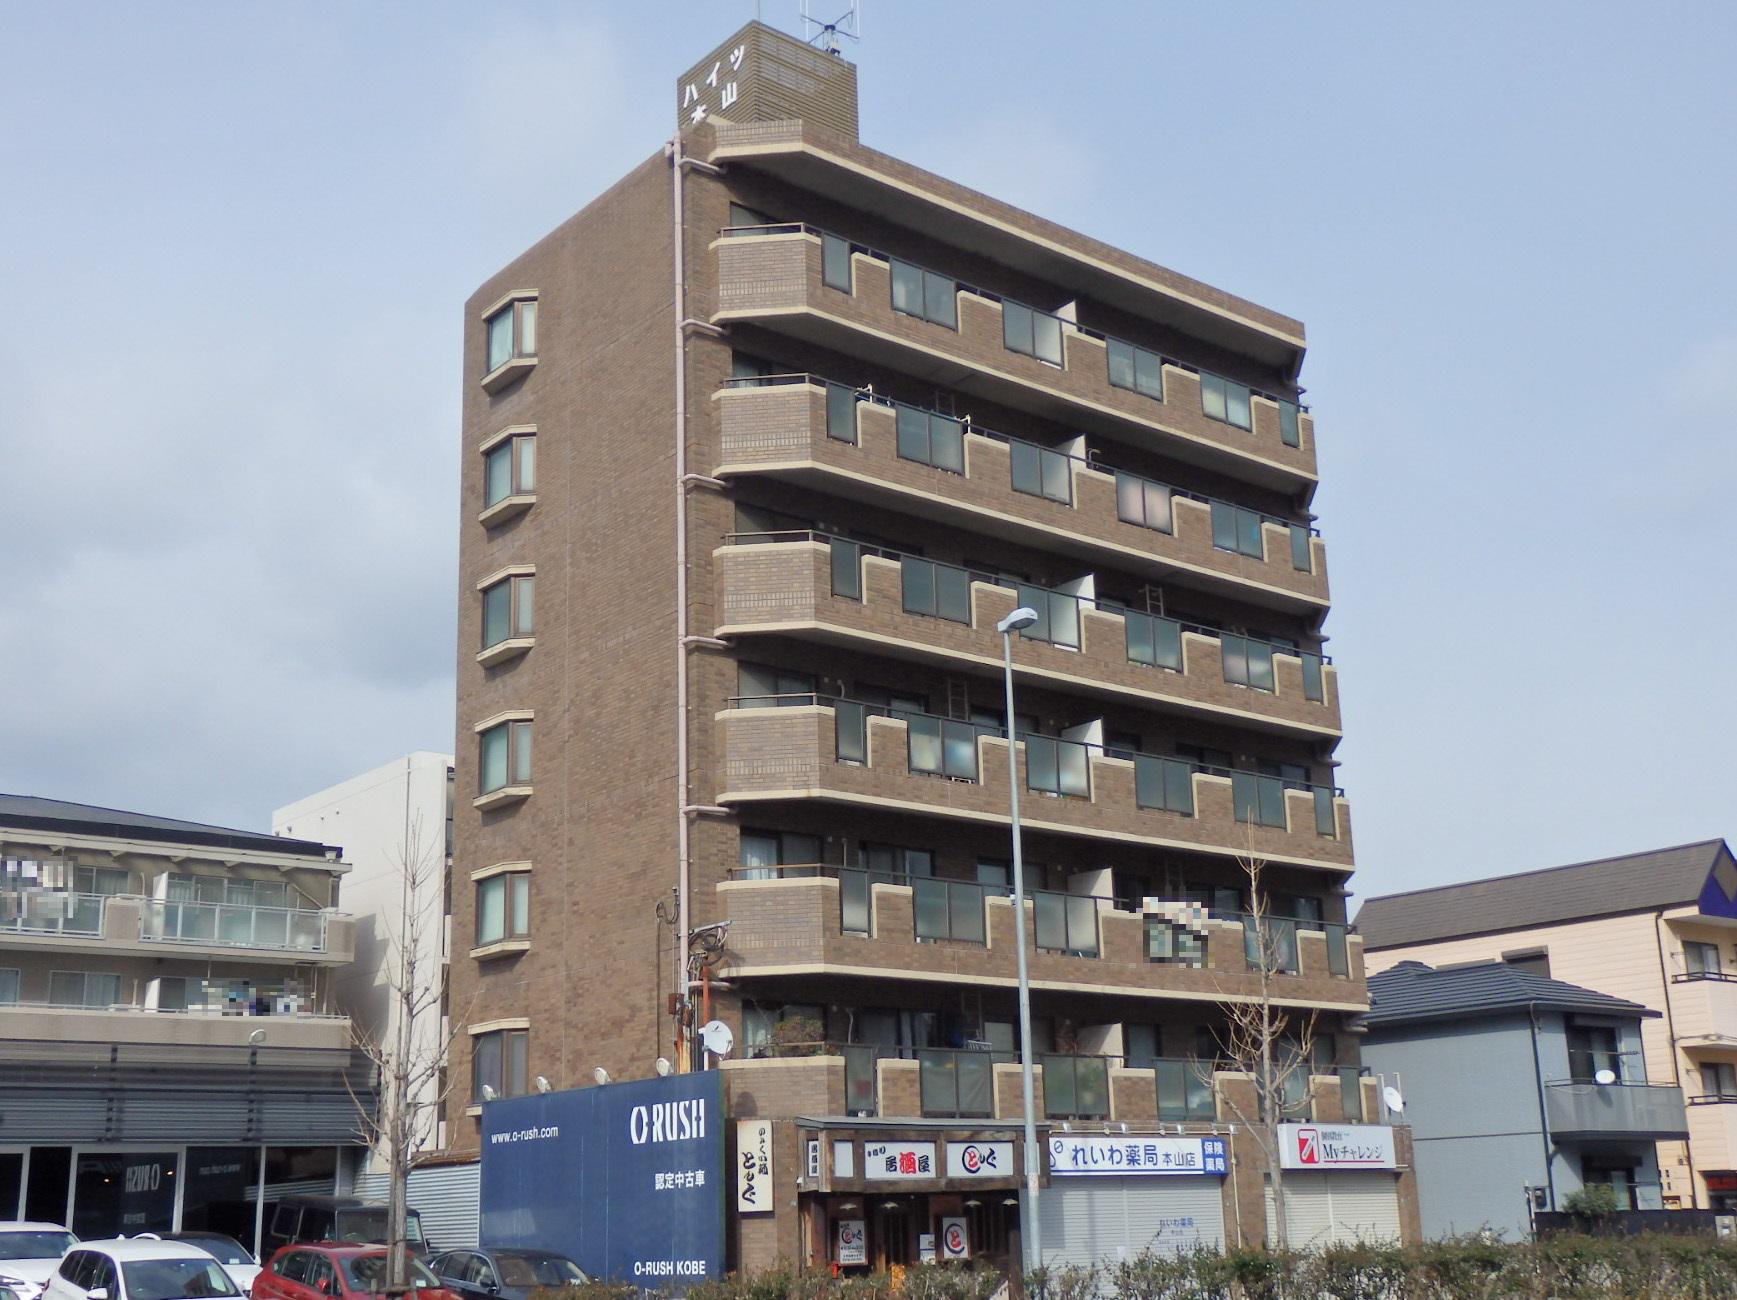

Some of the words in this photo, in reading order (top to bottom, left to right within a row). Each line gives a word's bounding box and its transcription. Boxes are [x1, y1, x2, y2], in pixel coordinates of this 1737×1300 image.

[683, 45, 745, 109] ハイツ
[491, 1125, 559, 1144] www.o-rush.com
[1071, 1144, 1159, 1167] れいわ薬局
[1162, 1152, 1196, 1167] 本山店
[1323, 1143, 1383, 1161] Myチャレンジ
[885, 1151, 931, 1175] 居酒屋
[654, 1170, 706, 1190] 認定中古車
[633, 1262, 674, 1276] O-RUSH
[676, 1260, 706, 1275] KOBE
